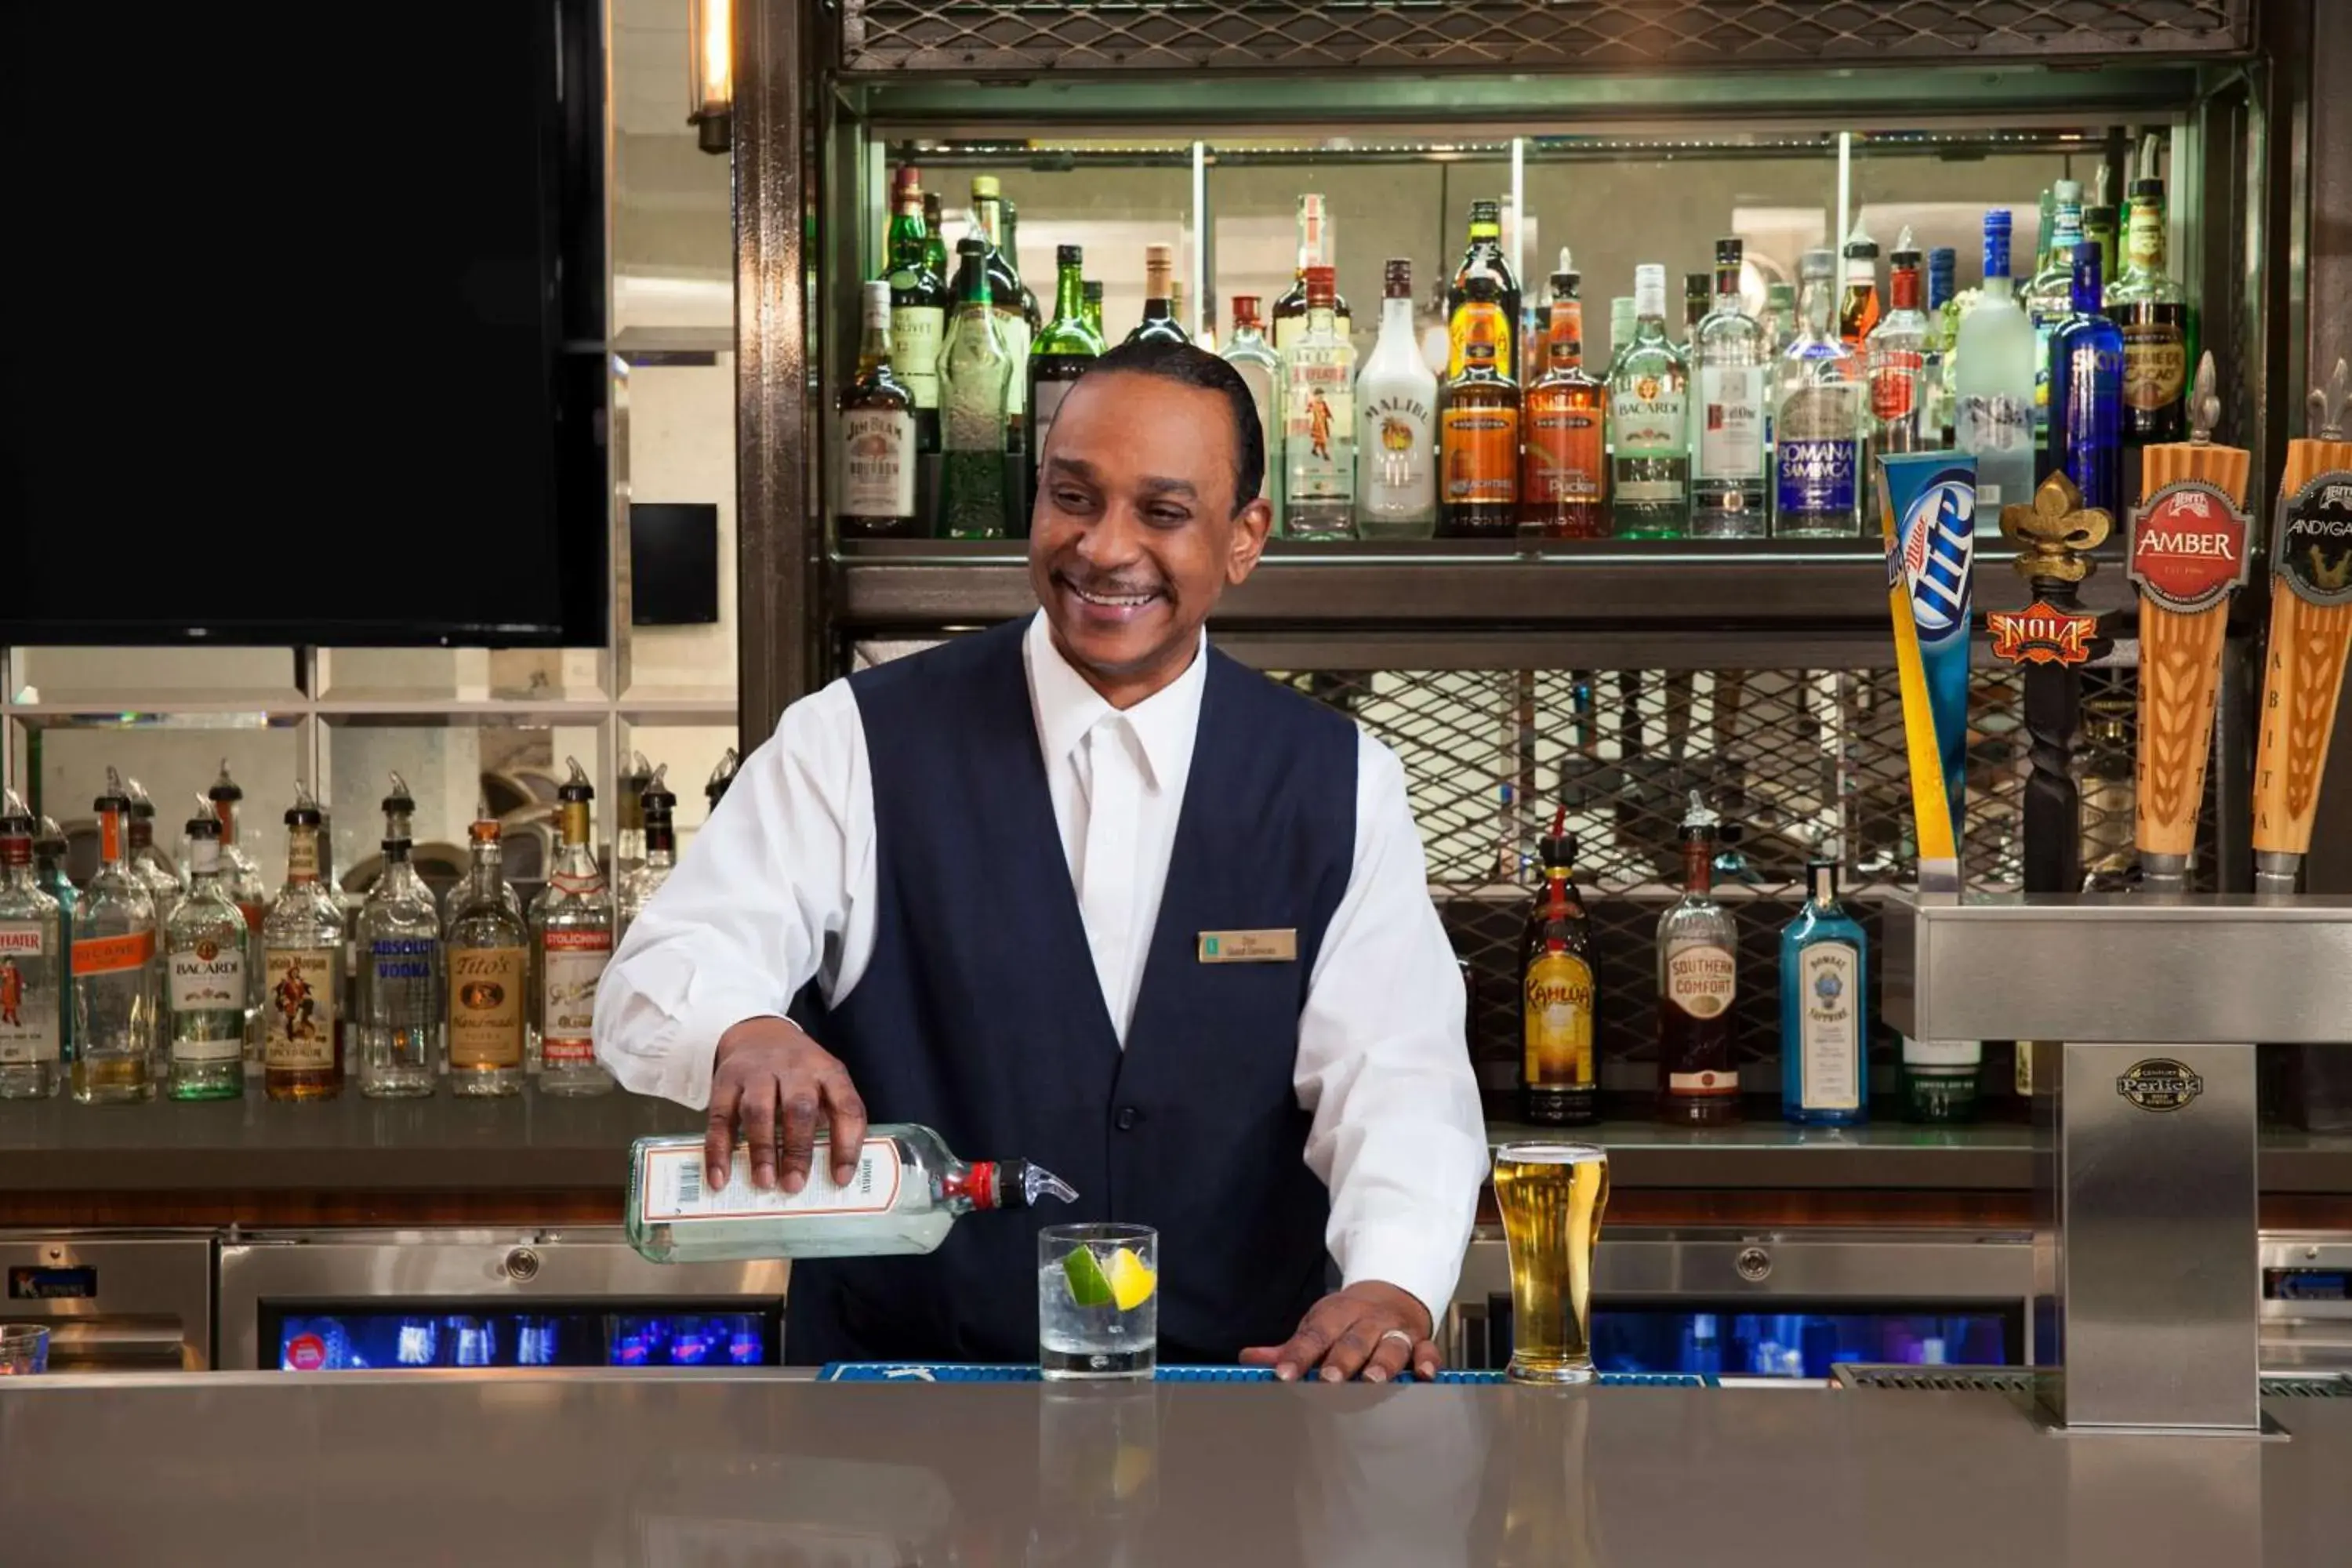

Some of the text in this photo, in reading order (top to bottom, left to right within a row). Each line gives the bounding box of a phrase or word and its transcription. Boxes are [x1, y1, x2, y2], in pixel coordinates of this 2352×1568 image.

[1618, 401, 1679, 416] BACARDI
[1778, 441, 1854, 463] ROMANA
[1905, 514, 1926, 575] Miller
[2136, 529, 2236, 561] AMBER
[2005, 615, 2078, 653] NOLA
[176, 961, 238, 975] BACARDI
[379, 963, 430, 978] VODKA
[456, 956, 510, 975] Tito's
[1671, 958, 1733, 976] SOUTHERN
[1810, 954, 1848, 971] BOMBAY
[1675, 979, 1731, 994] COMFORT
[2122, 1079, 2198, 1091] Perlick
